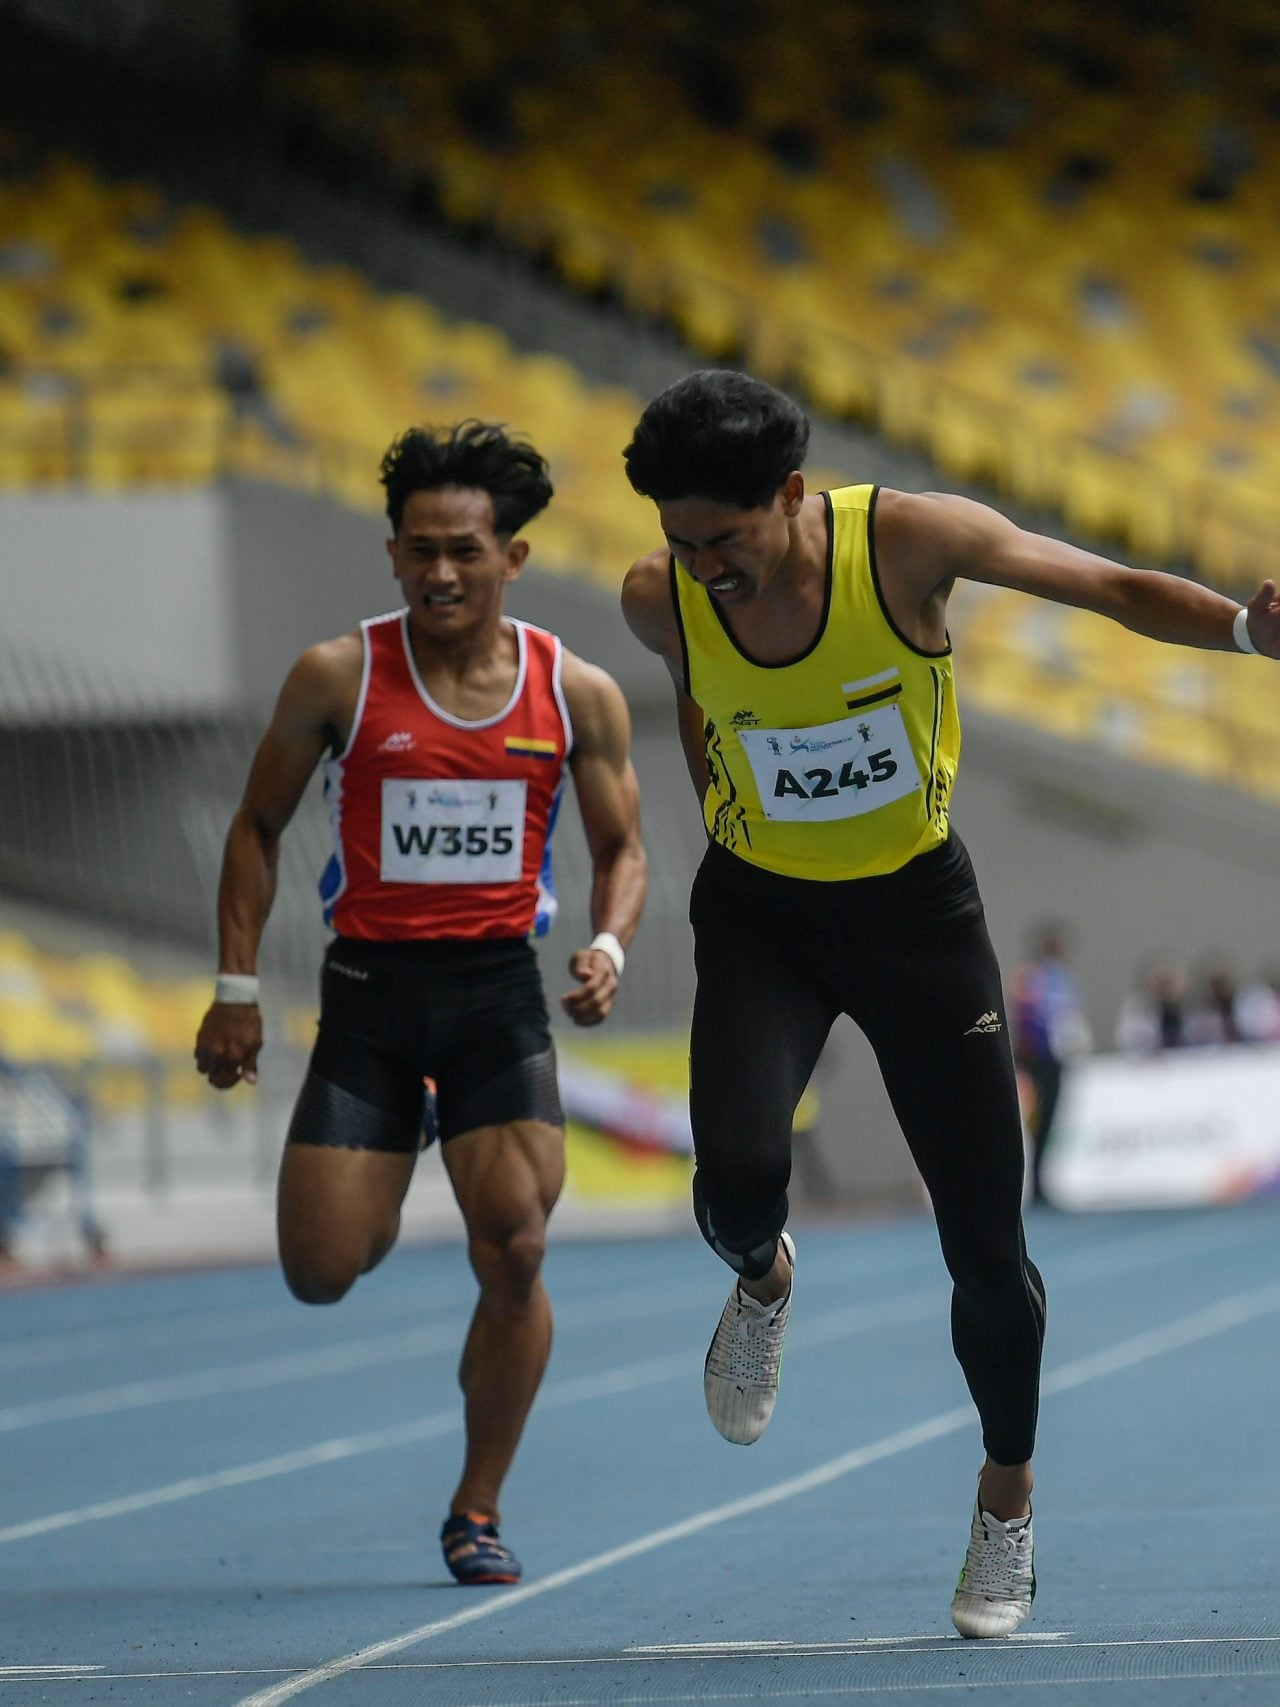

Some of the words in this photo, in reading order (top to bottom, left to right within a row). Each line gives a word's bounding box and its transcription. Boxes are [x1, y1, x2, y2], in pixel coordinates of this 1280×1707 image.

[773, 748, 898, 799] A245
[392, 825, 513, 856] W355
[963, 1023, 1003, 1036] AGT
